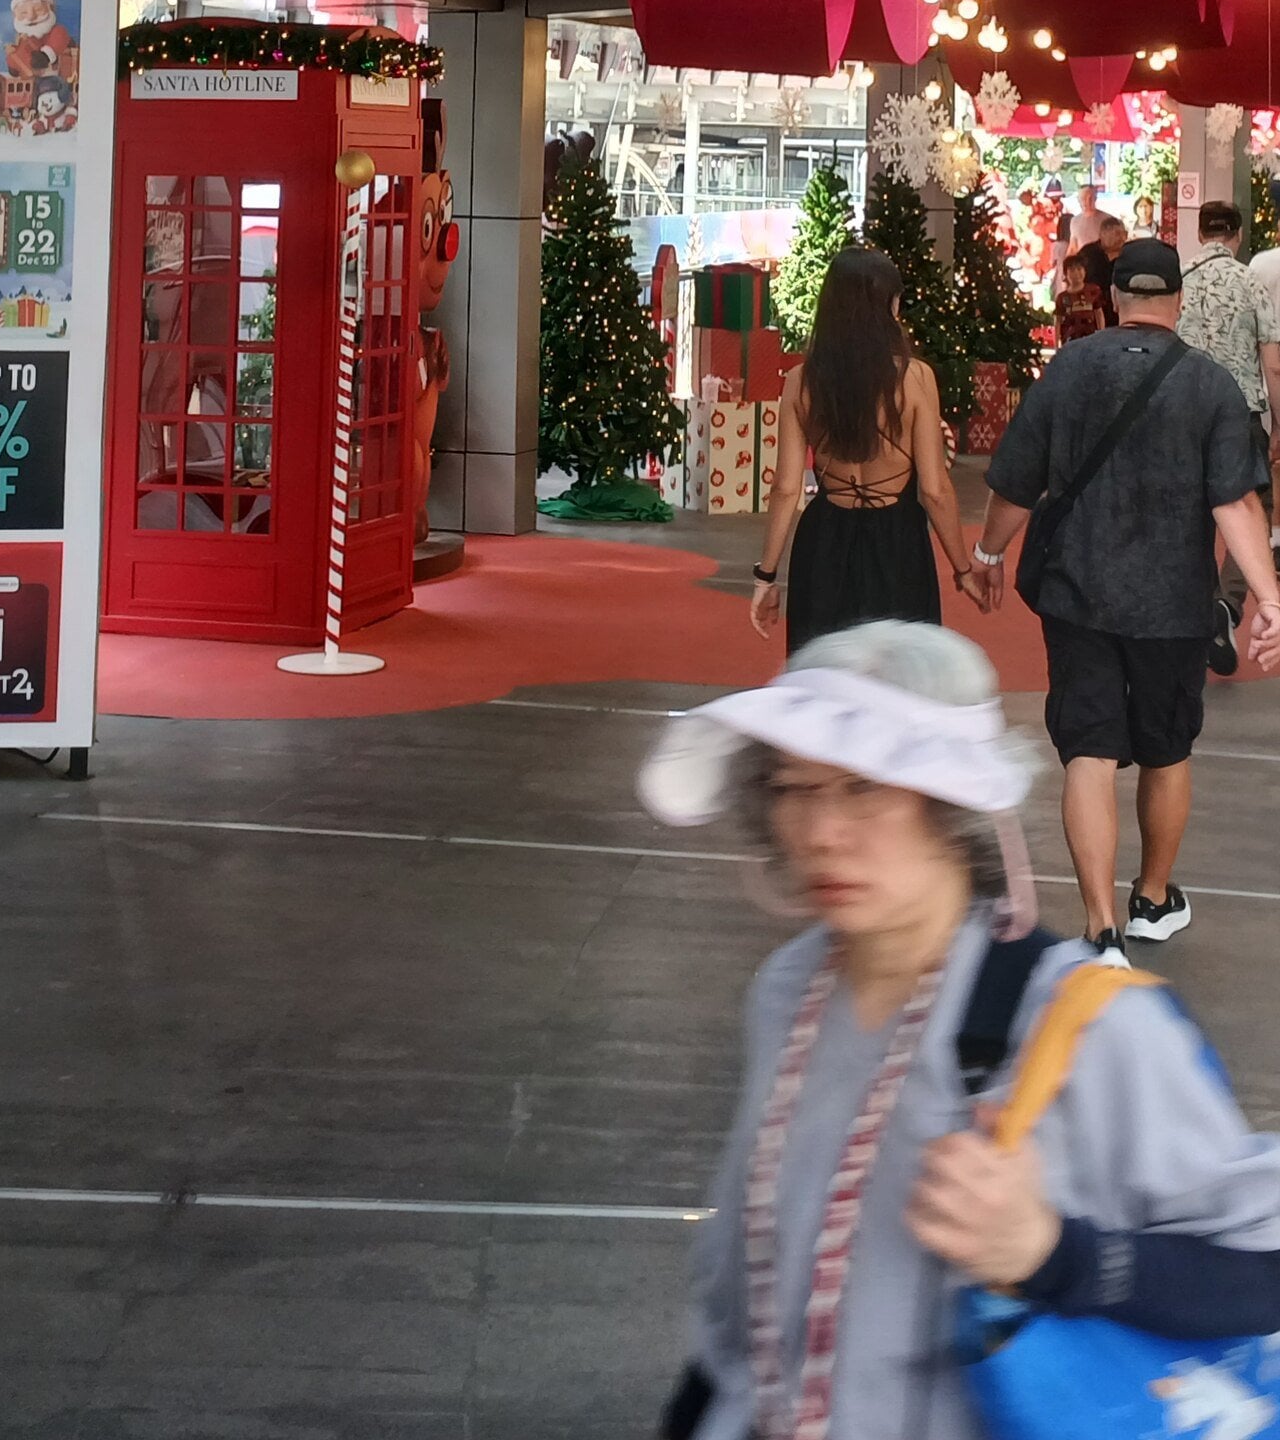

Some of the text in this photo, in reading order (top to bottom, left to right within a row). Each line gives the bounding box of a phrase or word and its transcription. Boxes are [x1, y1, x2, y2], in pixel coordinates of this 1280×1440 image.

[143, 75, 287, 92] SANTA HOTLINE
[24, 194, 52, 220] 15
[31, 219, 44, 230] to
[17, 229, 56, 254] 22
[17, 255, 56, 266] Dec 25
[7, 363, 37, 391] TO
